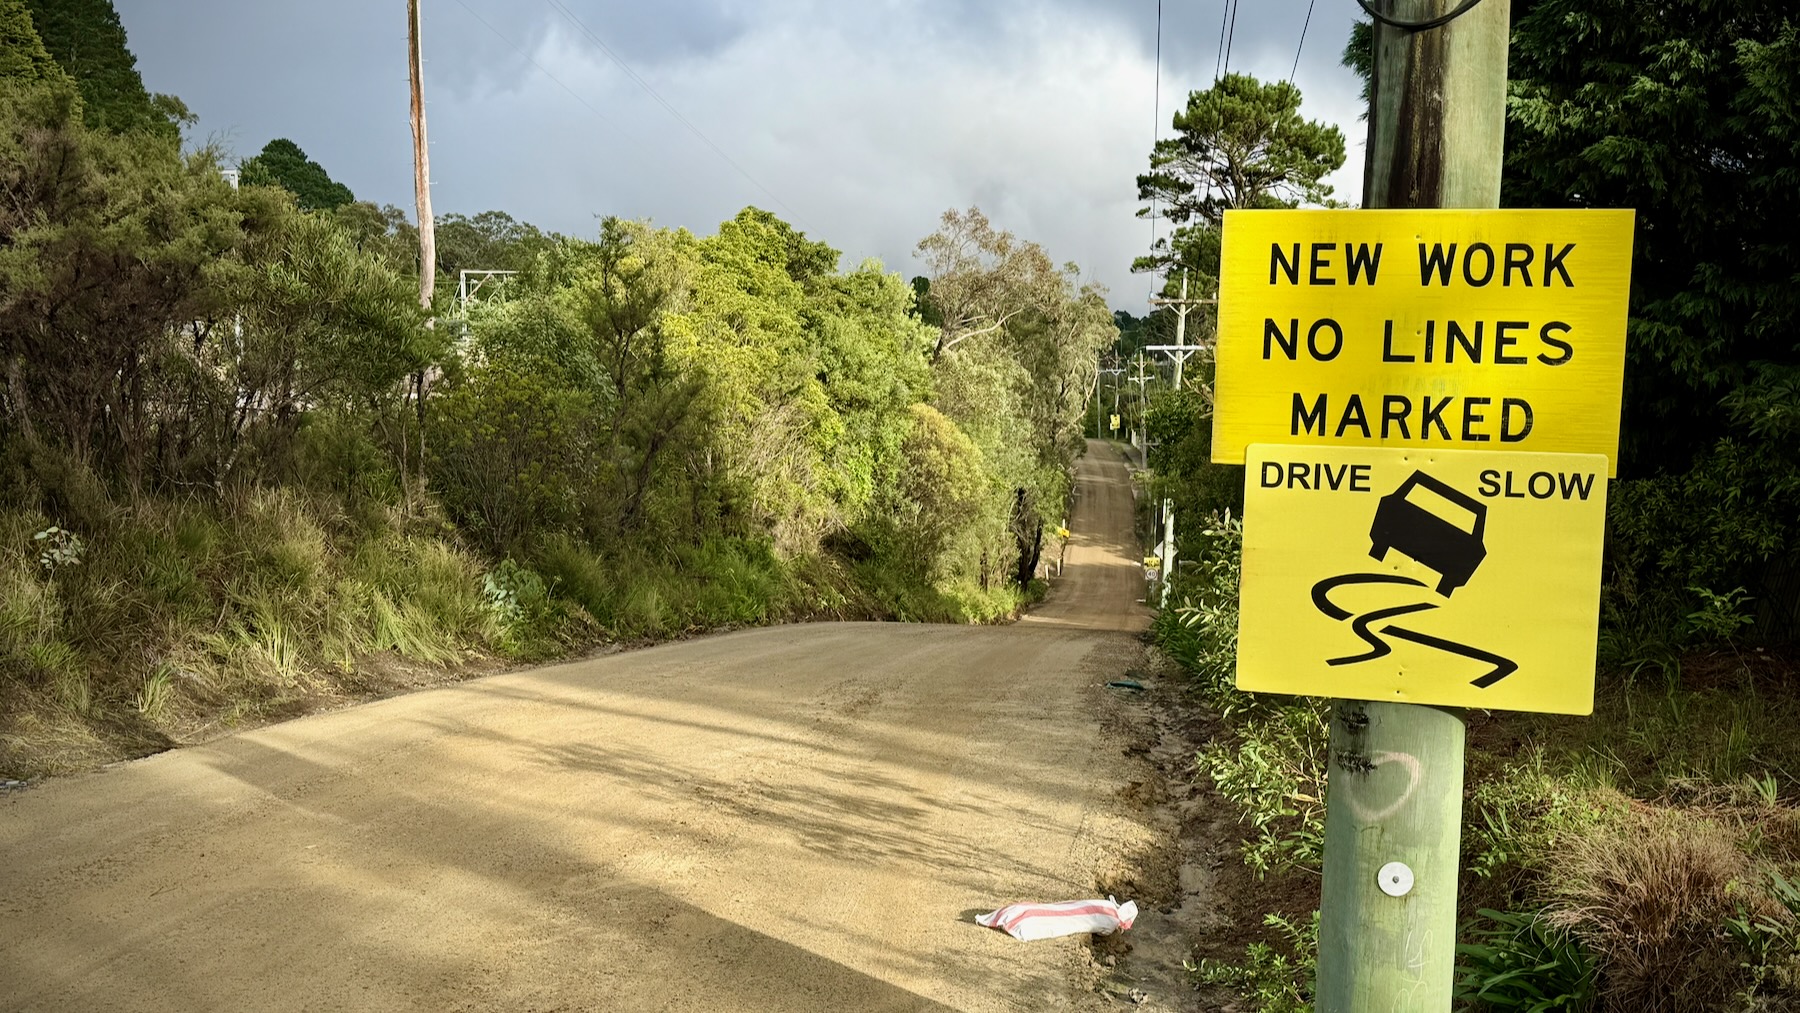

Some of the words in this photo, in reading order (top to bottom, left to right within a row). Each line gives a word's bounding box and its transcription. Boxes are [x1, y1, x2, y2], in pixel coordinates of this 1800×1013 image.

[1269, 242, 1383, 287] NEW
[1418, 242, 1577, 288] WORK
[1262, 318, 1344, 362] NO
[1382, 319, 1574, 367] LINES
[1290, 392, 1535, 443] MARKED
[1260, 461, 1372, 492] DRIVE
[1478, 469, 1596, 501] SLOW
